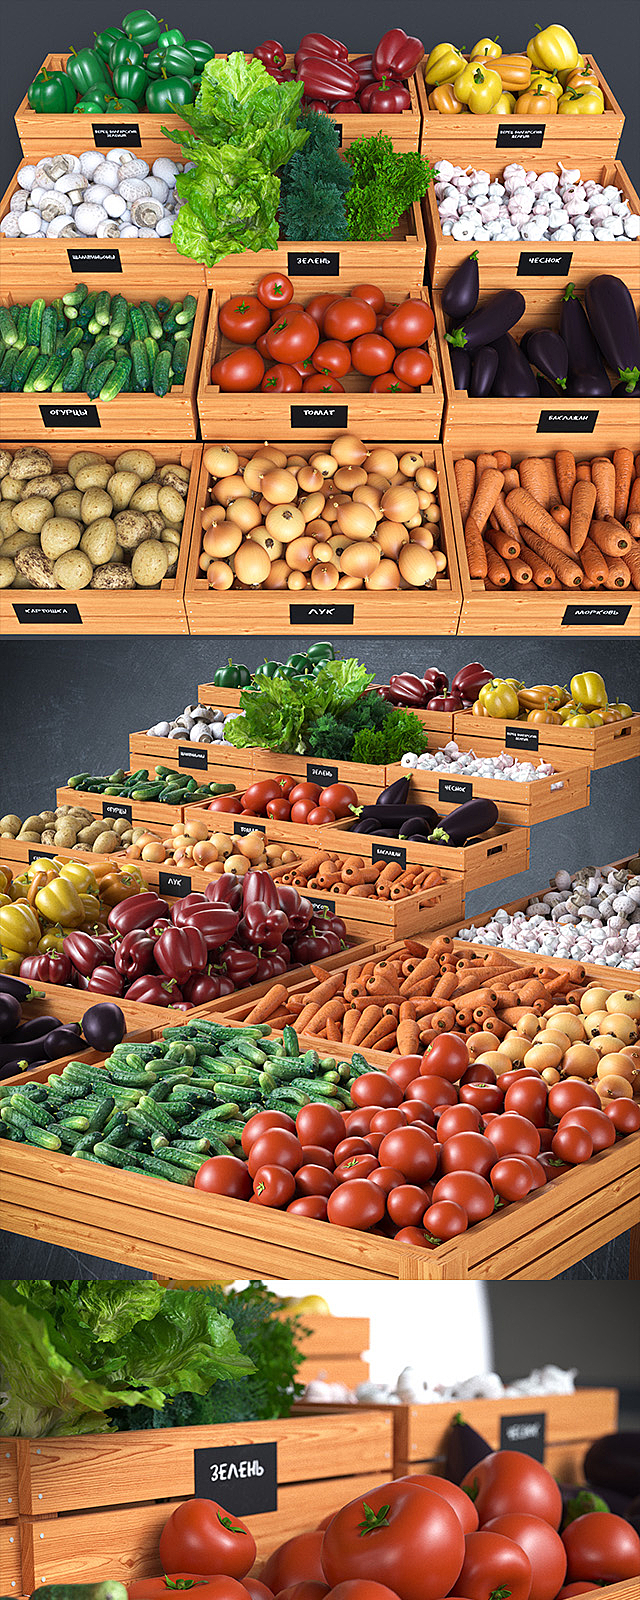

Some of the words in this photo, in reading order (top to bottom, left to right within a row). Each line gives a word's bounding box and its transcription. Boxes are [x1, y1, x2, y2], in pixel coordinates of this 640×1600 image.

[528, 256, 562, 264] ЧЕСНОК
[50, 409, 88, 417] ОГУРЦЫ
[167, 877, 182, 887] ЛУК
[209, 1460, 265, 1482] ЗЕЛЕНЬ
